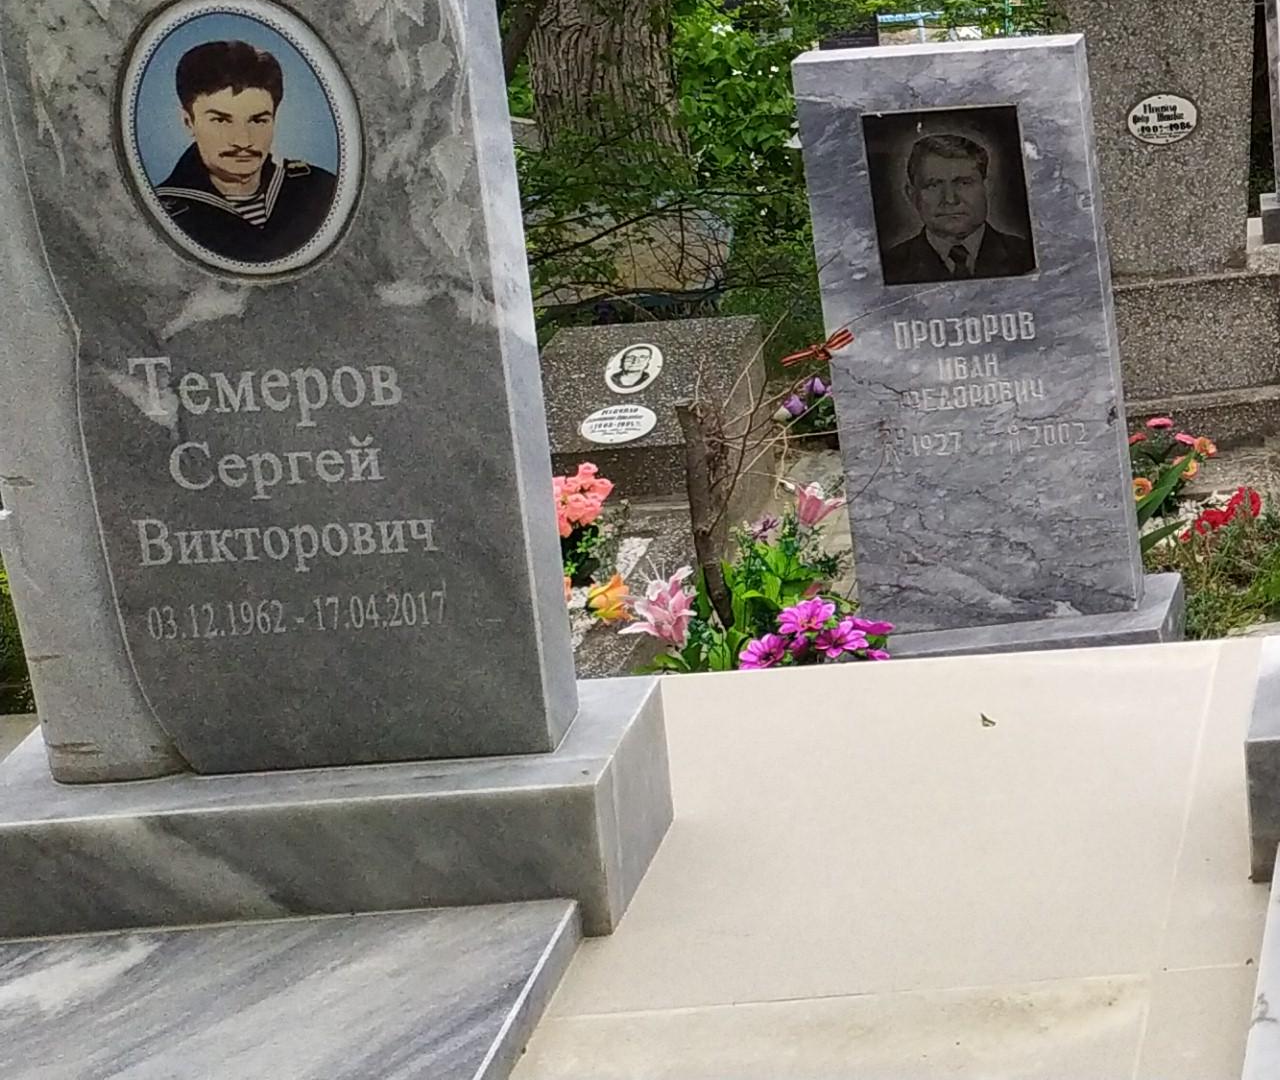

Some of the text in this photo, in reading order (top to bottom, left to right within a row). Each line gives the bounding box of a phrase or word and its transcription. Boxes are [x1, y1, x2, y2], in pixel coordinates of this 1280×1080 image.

[893, 310, 1036, 350] ПРОЗОРОВ
[127, 355, 404, 426] Темеров
[937, 353, 1000, 382] ИВАН
[900, 378, 1046, 412] ФЕДОРОВИЧ
[168, 436, 386, 500] Сергей
[131, 518, 441, 572] Викторович
[147, 598, 287, 641] 03.12.1962
[312, 588, 447, 632] 17.04.2017
